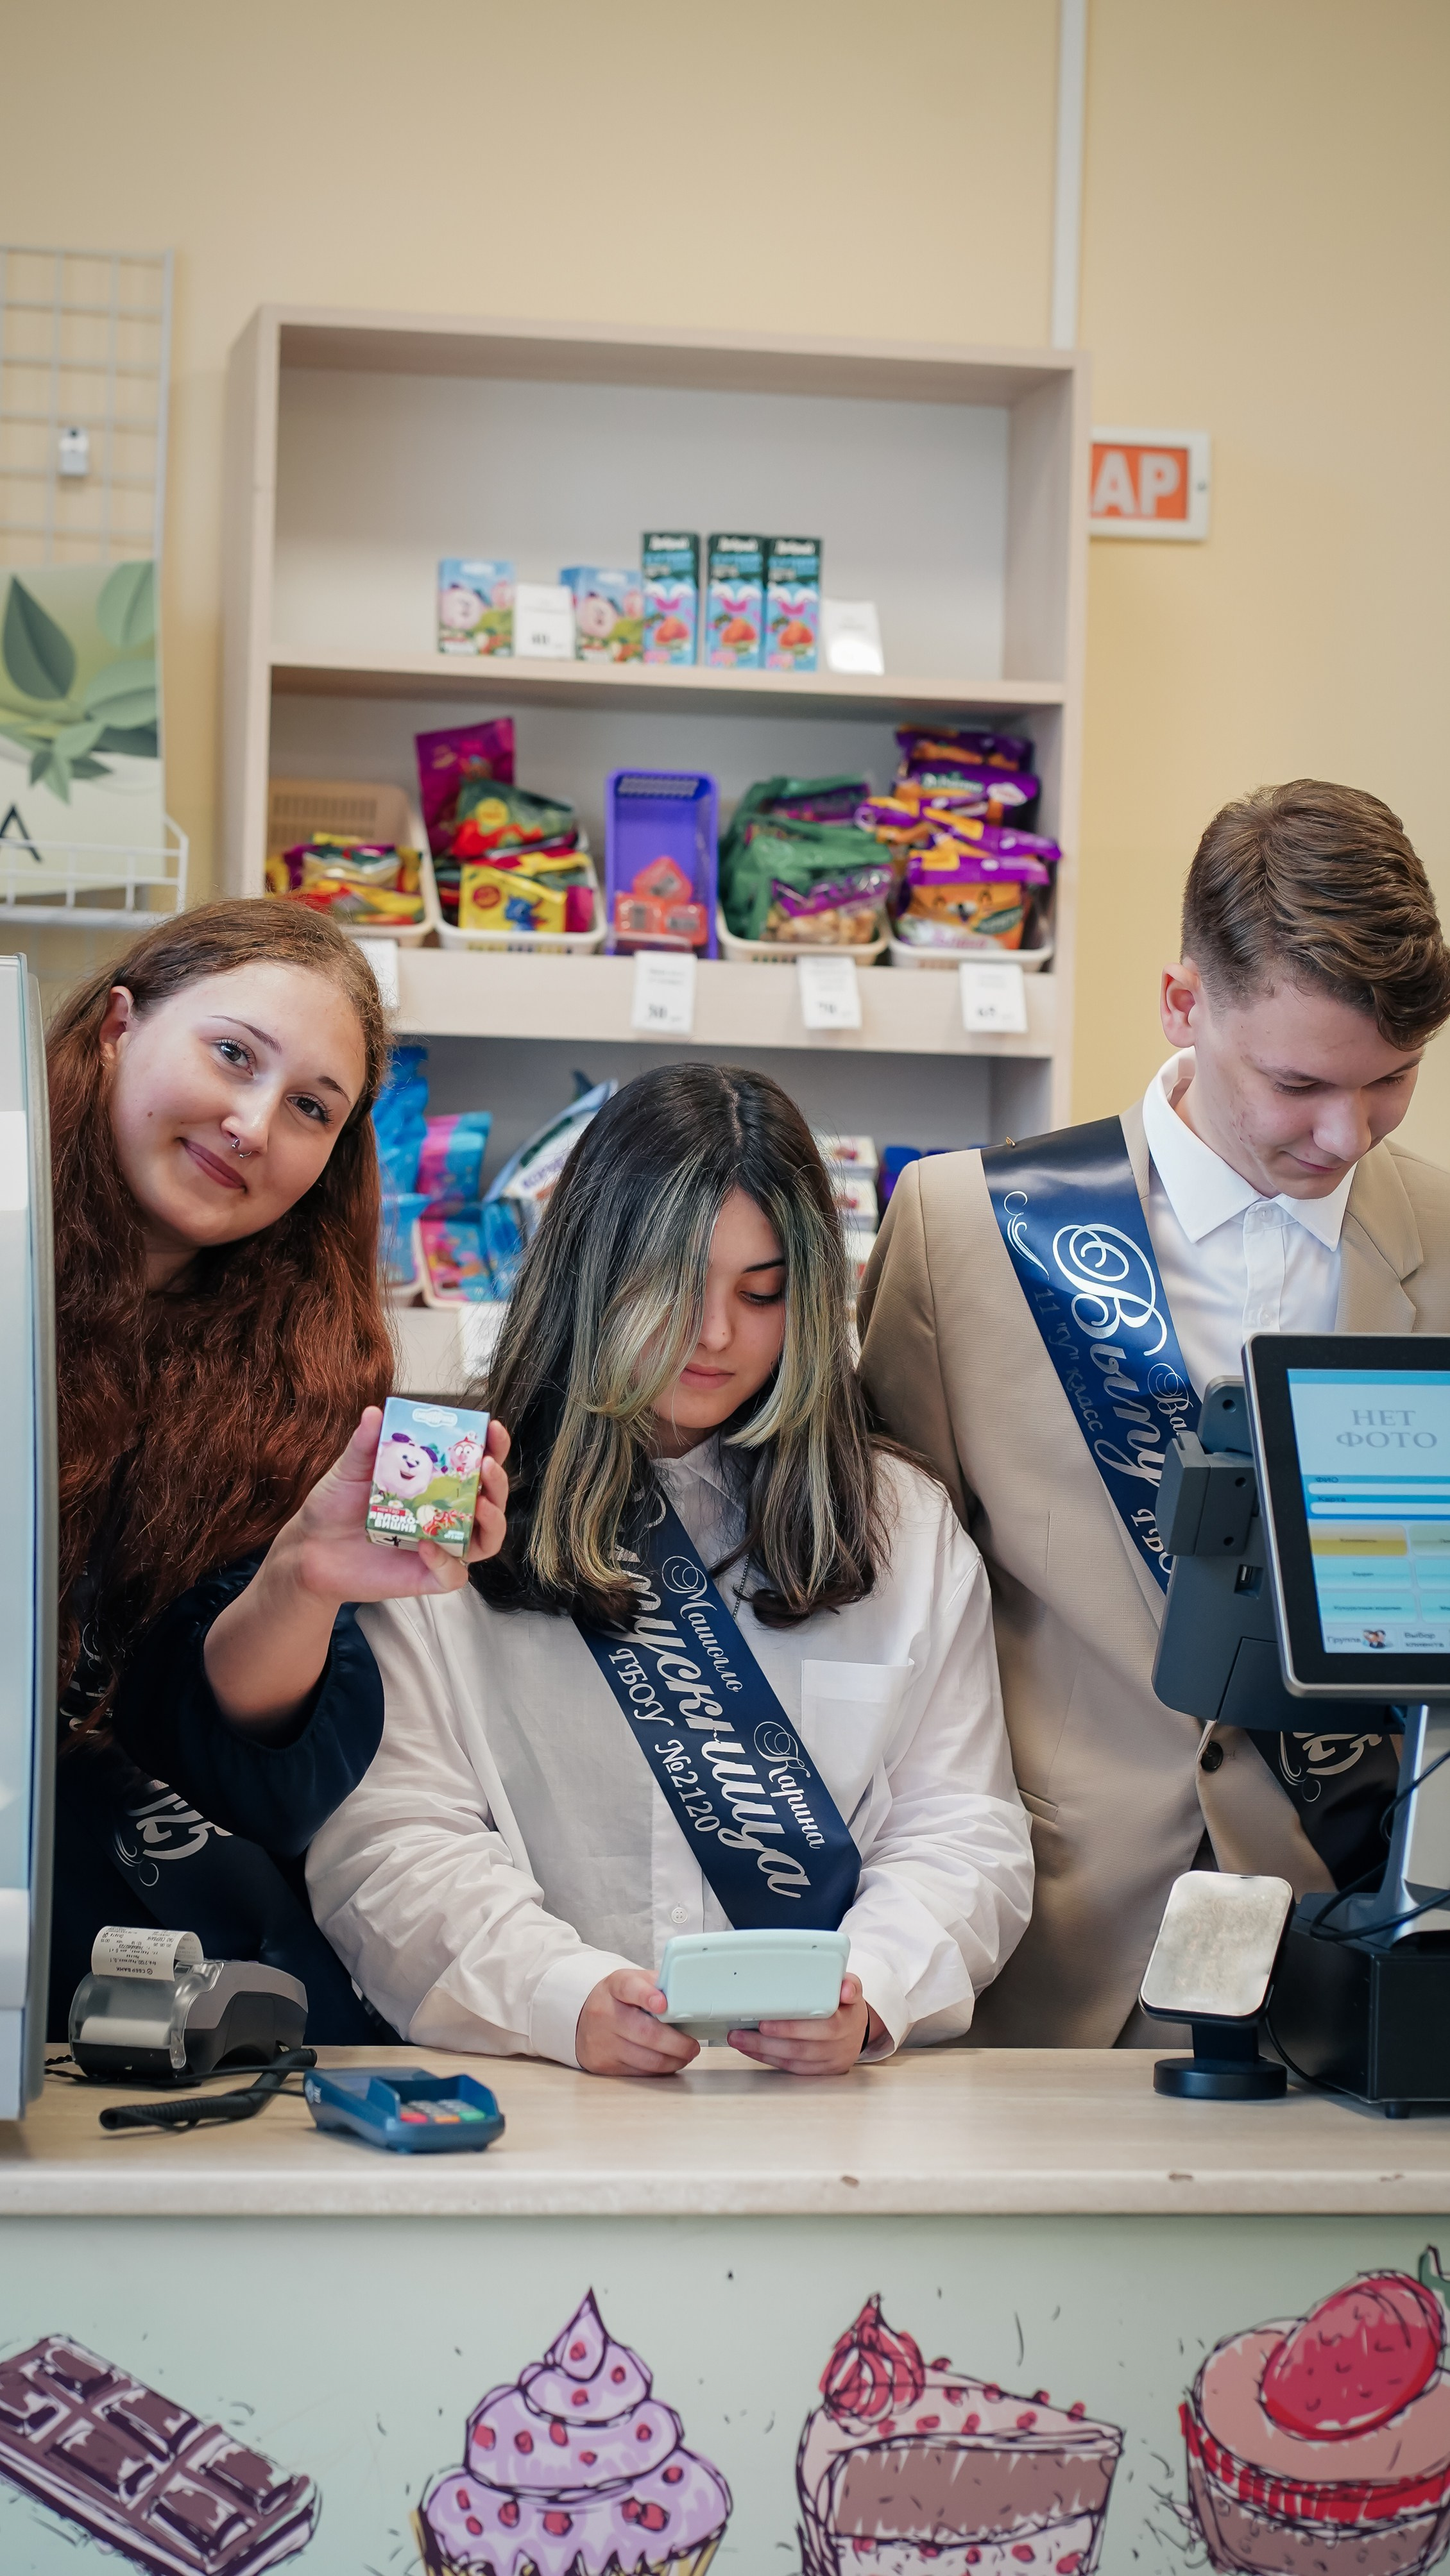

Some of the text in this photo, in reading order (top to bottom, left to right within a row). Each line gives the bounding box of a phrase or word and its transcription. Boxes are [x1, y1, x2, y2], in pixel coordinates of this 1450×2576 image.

[1033, 1287, 1061, 1316] 11
[1064, 1366, 1104, 1432] класс
[1351, 1409, 1416, 1426] НЕТ
[1336, 1431, 1438, 1448] ФОТО
[374, 1520, 417, 1534] ВИШНЯ
[662, 1555, 743, 1693] Машогло
[608, 1648, 720, 1832] ГБОУ №2120
[754, 1721, 826, 1849] Карина
